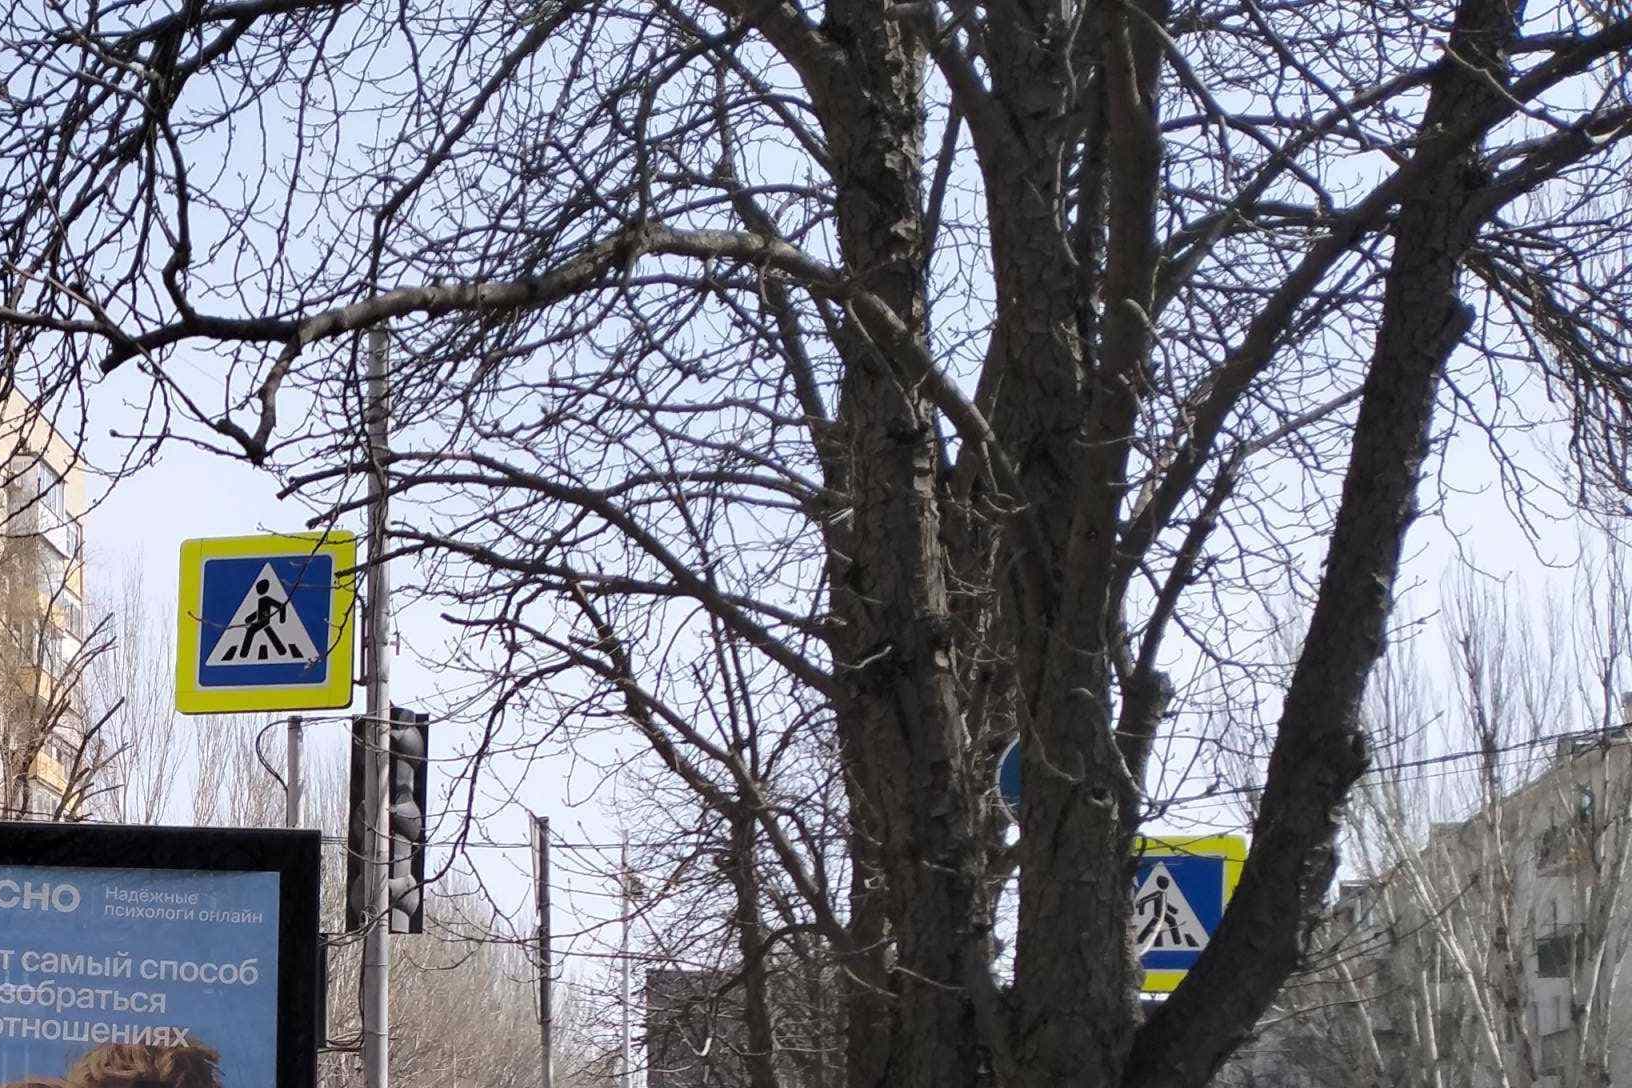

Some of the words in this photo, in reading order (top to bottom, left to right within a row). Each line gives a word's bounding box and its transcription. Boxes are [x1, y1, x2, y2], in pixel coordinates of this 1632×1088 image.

[104, 886, 199, 906] Надёжные
[104, 905, 195, 922] психологи
[198, 908, 264, 924] онлайн
[21, 951, 133, 979] самый
[139, 957, 260, 985] способ
